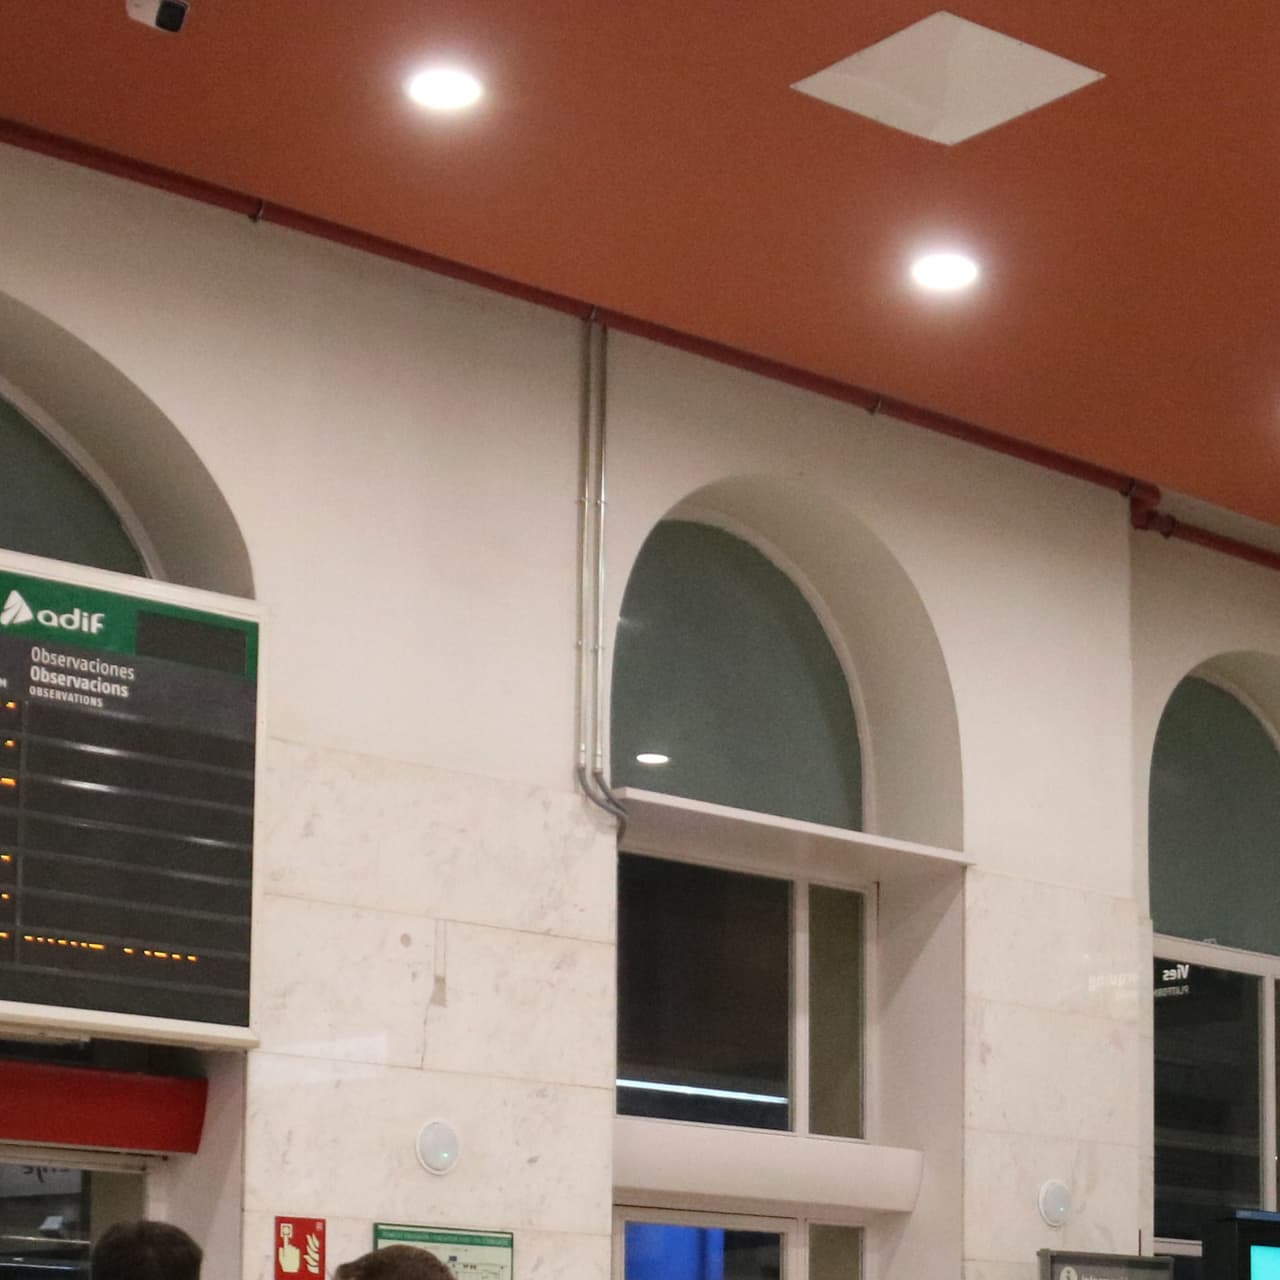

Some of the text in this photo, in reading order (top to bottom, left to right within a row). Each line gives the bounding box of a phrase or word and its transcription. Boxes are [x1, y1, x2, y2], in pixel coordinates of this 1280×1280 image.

[37, 607, 106, 635] adif
[30, 645, 135, 681] Observaciones
[29, 665, 129, 698] Observacions
[29, 685, 104, 708] OBSERVATIONS
